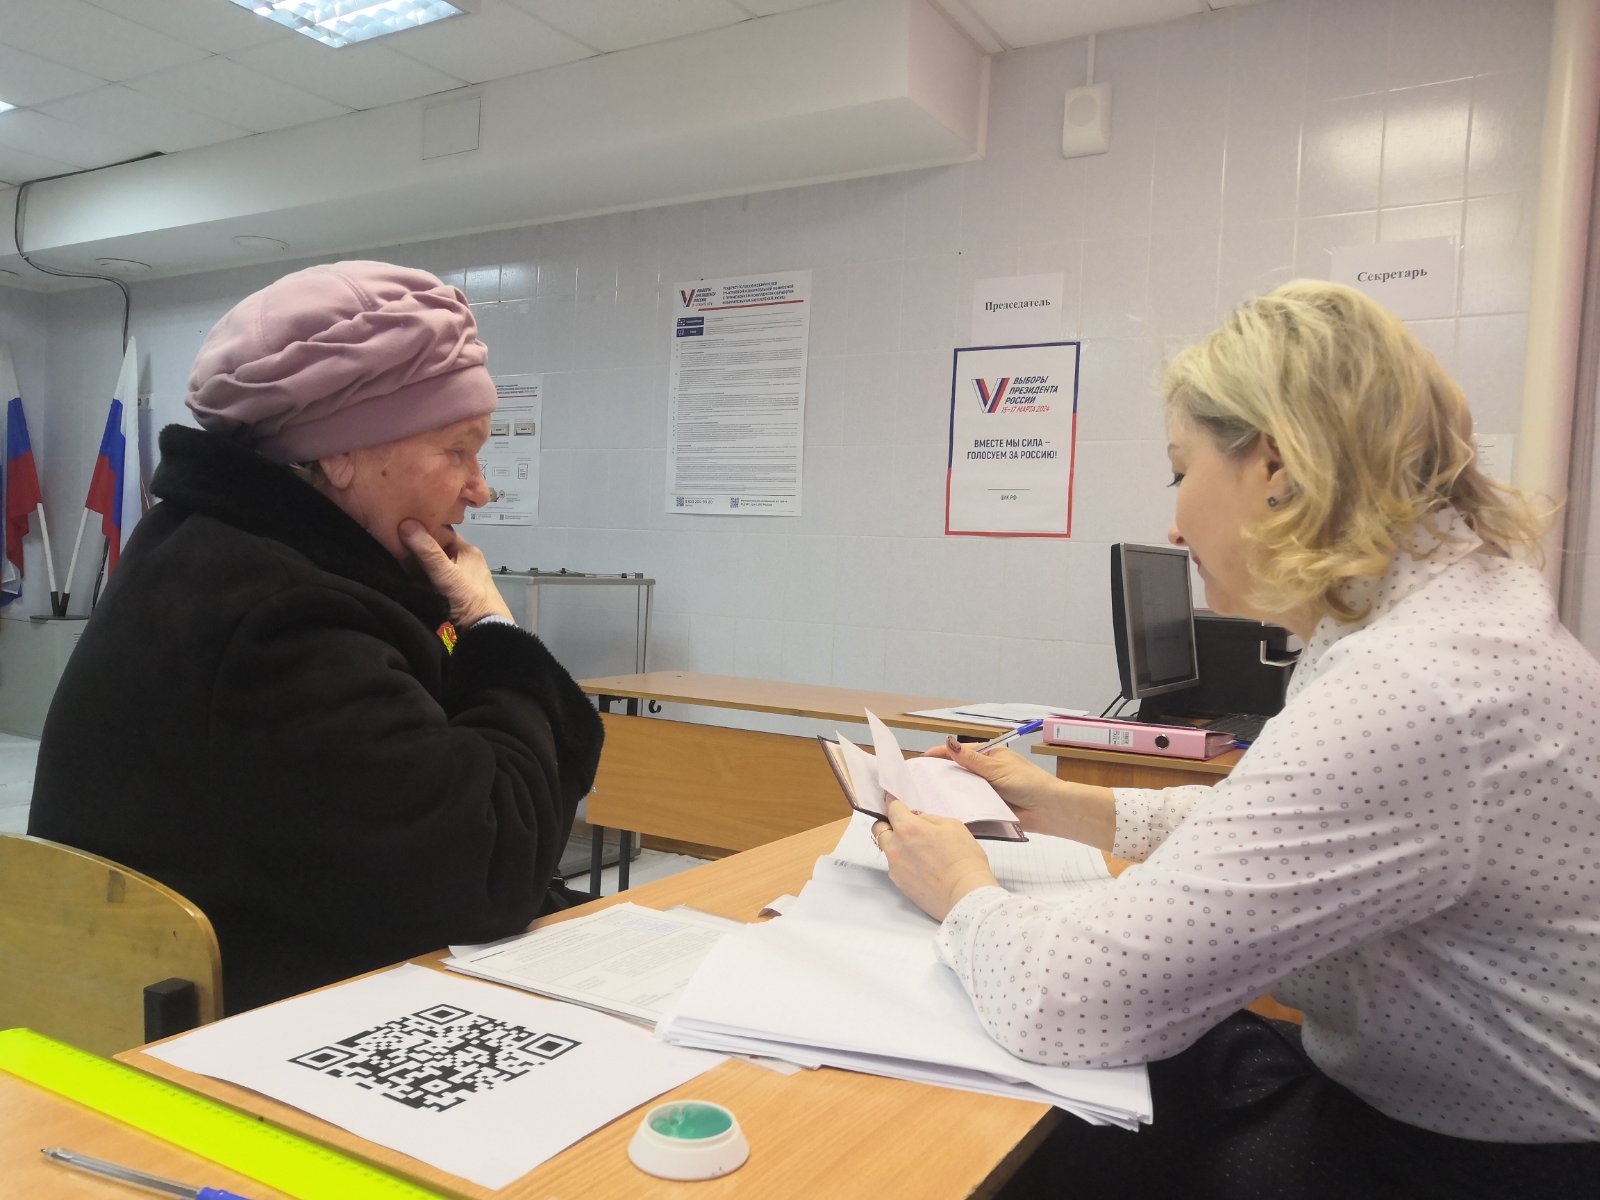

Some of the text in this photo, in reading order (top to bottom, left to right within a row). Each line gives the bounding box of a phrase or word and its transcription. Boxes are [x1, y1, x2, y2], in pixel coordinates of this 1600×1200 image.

[1357, 268, 1427, 283] Секретарь
[985, 299, 1051, 312] Председатель
[1013, 376, 1048, 385] ВЫБОРЫ
[1009, 385, 1058, 395] ПРЕЗИДЕНТА
[1005, 396, 1037, 405] РОССИИ
[1017, 405, 1036, 413] МАРТА
[1036, 405, 1050, 413] 2024
[974, 439, 1004, 448] ВМЕСТЕ
[1006, 439, 1020, 448] МЫ
[1021, 438, 1043, 447] СИЛА
[967, 450, 1057, 460] ГОЛОСУЕМ ЗА РОССИЮ!
